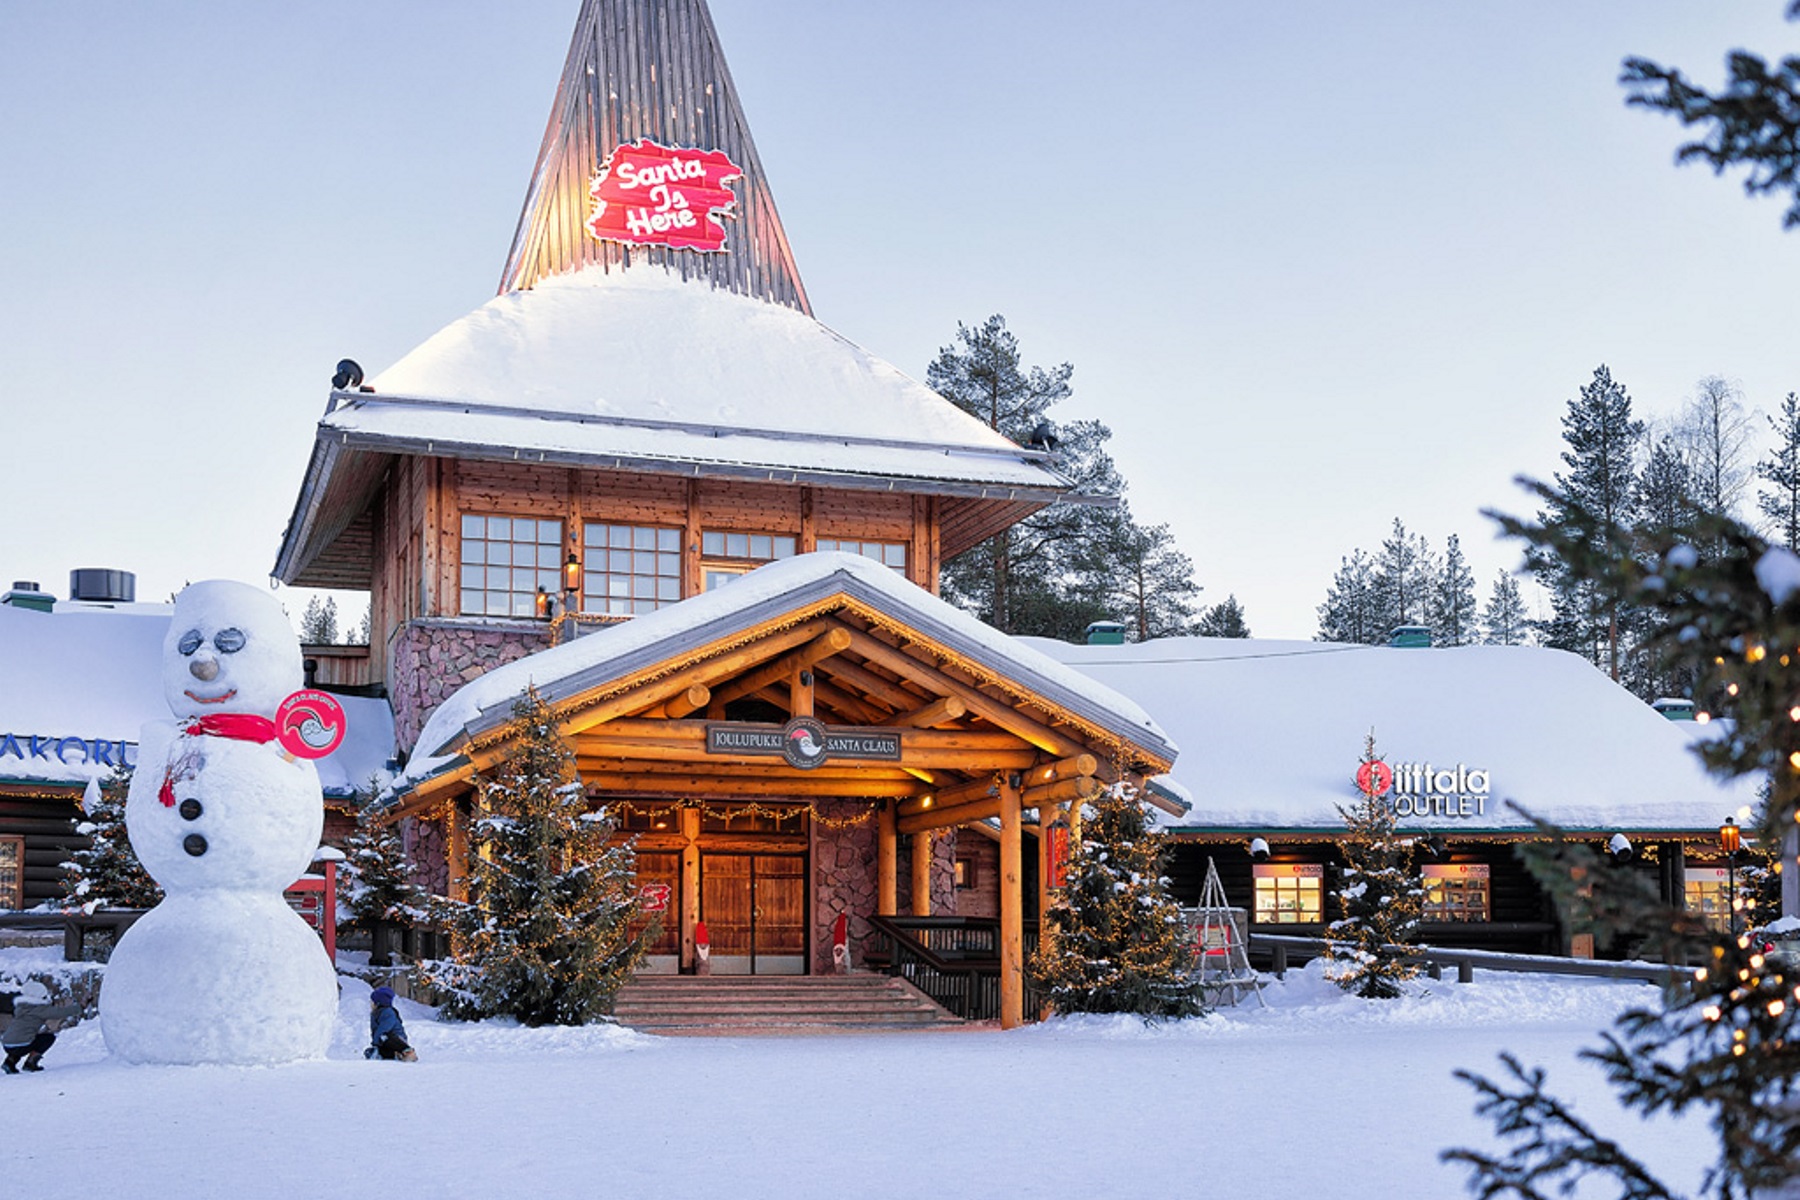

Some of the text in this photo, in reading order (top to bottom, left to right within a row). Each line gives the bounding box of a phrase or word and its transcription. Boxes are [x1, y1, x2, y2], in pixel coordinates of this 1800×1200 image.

[616, 156, 706, 189] Santa
[649, 185, 689, 212] Is
[626, 207, 697, 236] Here
[715, 732, 782, 747] JOULUPUKKI
[827, 738, 895, 753] SANTA CLAUS
[1395, 763, 1490, 794] iittala
[1395, 796, 1489, 816] OUTLET
